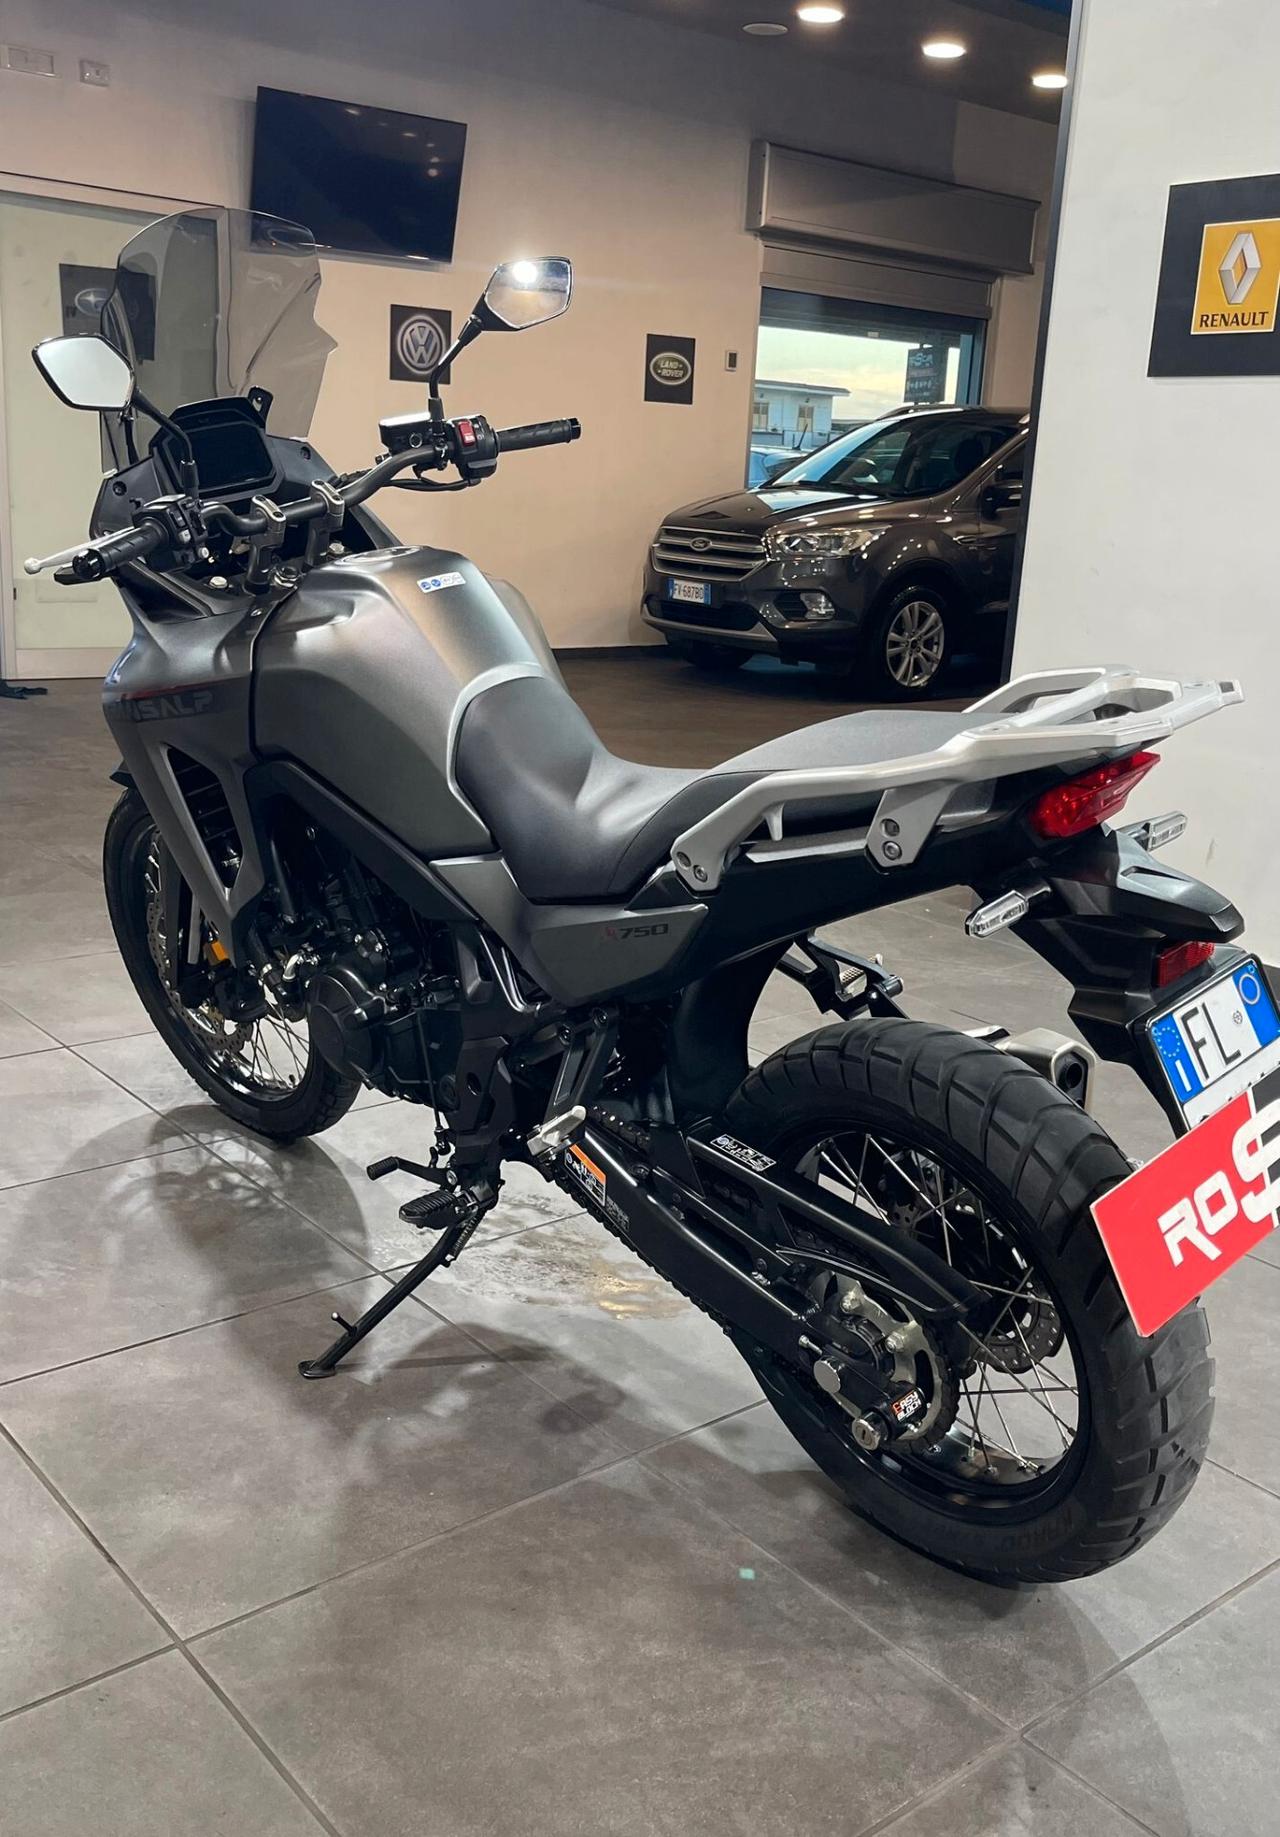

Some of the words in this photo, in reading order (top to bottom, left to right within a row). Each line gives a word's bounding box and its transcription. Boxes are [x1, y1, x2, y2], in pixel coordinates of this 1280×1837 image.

[1199, 311, 1269, 328] RENAULT
[660, 360, 679, 369] LAND
[661, 368, 684, 378] ROVER
[1180, 1002, 1242, 1081] FL
[892, 1391, 919, 1415] EASY
